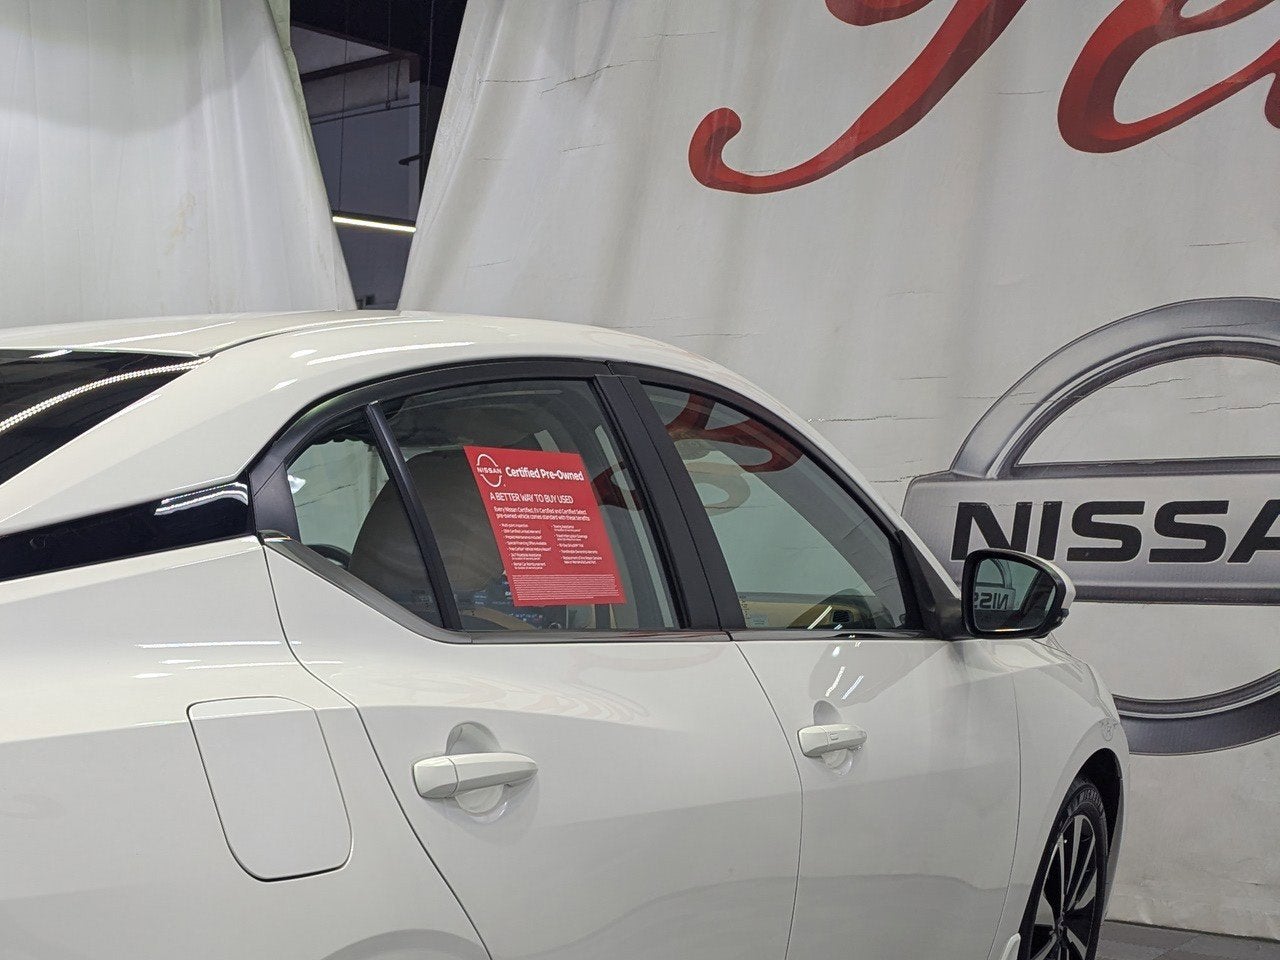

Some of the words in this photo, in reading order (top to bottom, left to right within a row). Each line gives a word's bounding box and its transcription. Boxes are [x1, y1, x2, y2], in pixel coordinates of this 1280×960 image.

[476, 466, 503, 474] NISSAN
[505, 466, 541, 479] Certified
[540, 468, 585, 481] Pre-Owned
[489, 492, 496, 501] A
[495, 492, 522, 502] BETTER
[521, 494, 535, 502] WAY
[534, 494, 544, 503] TO
[544, 494, 557, 503] BUY
[557, 495, 574, 504] USED
